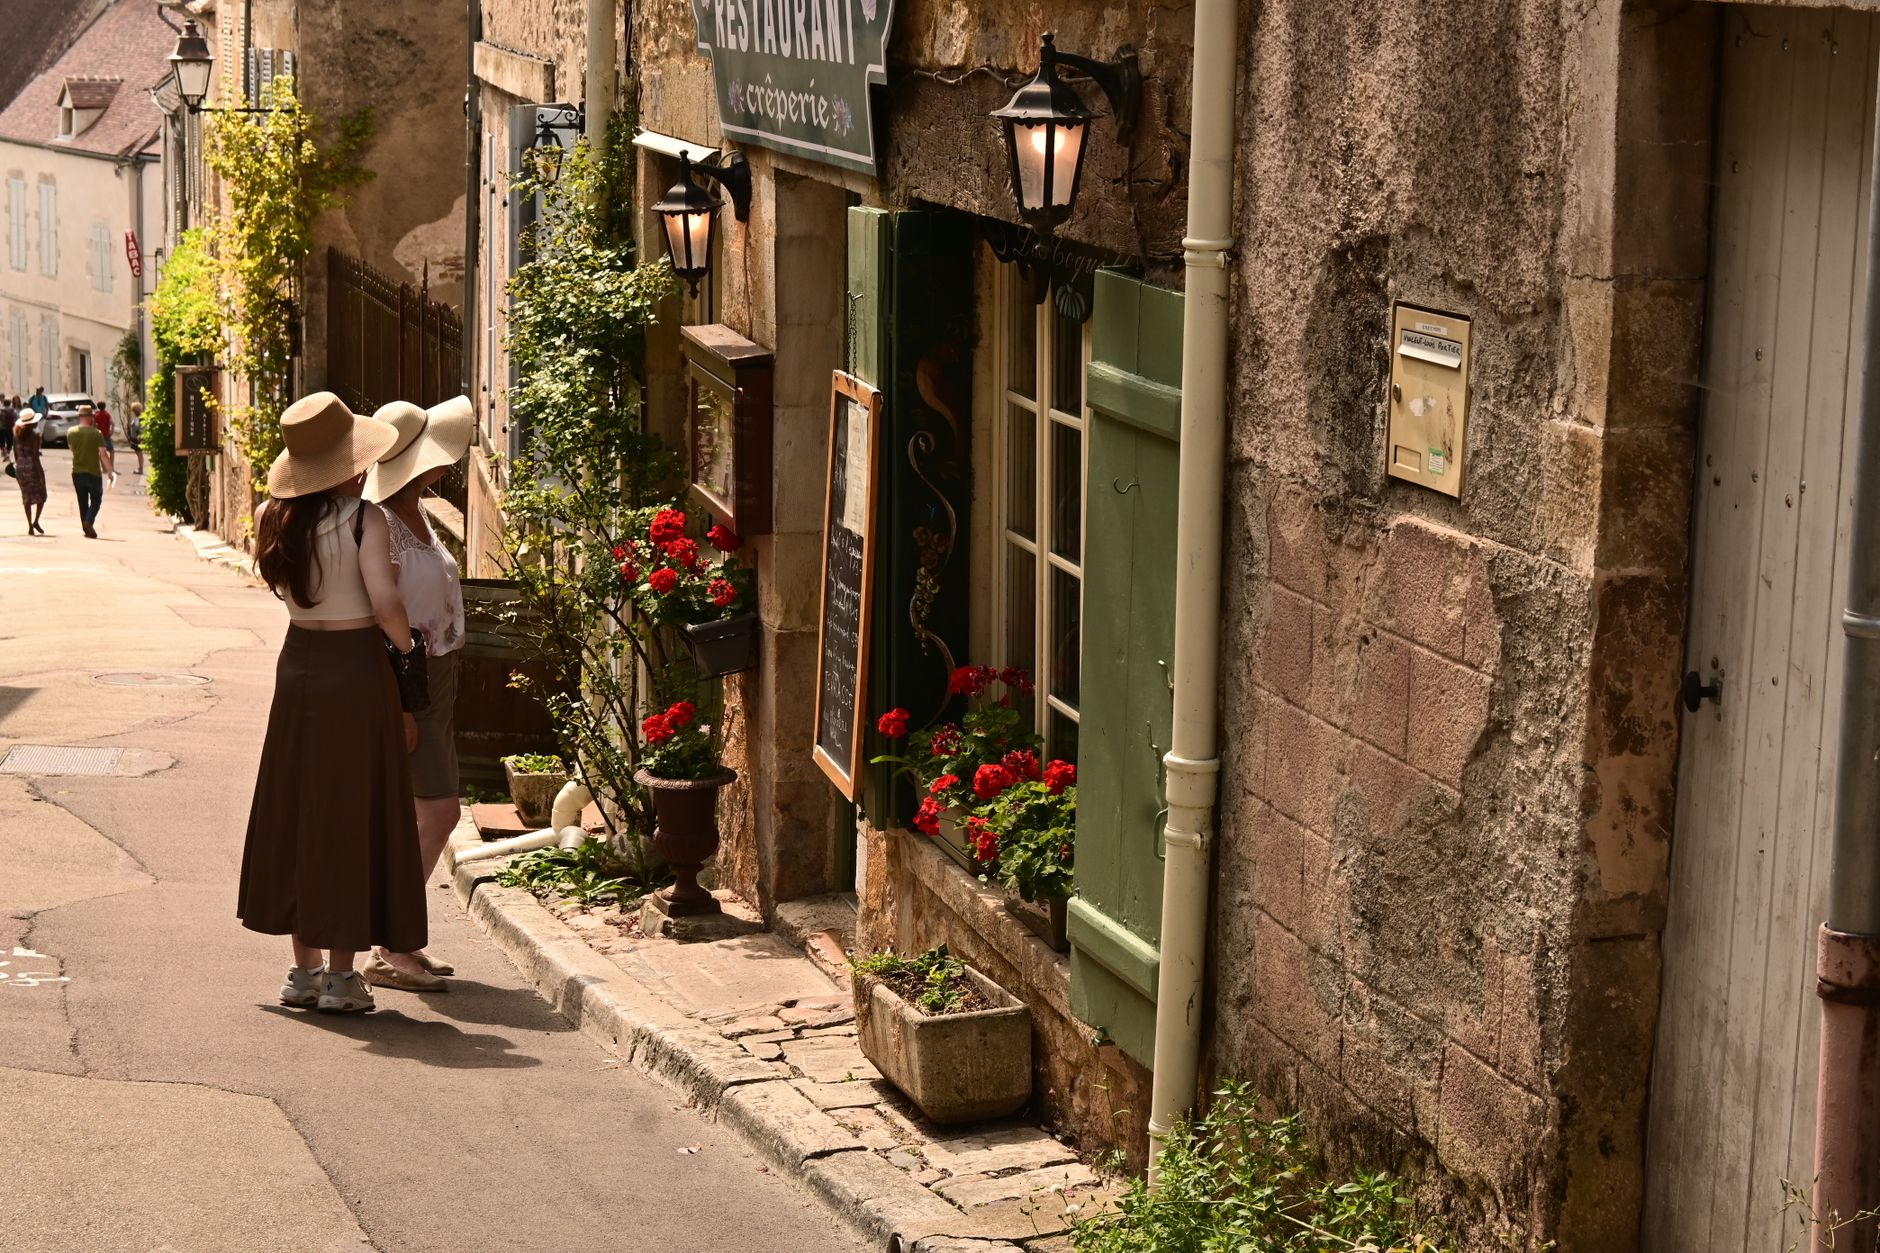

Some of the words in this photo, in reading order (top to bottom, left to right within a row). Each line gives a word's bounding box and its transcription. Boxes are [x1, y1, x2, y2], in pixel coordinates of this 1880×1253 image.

[714, 0, 856, 65] RESTAURANT
[746, 72, 830, 131] crêperie
[125, 229, 141, 276] TABAC
